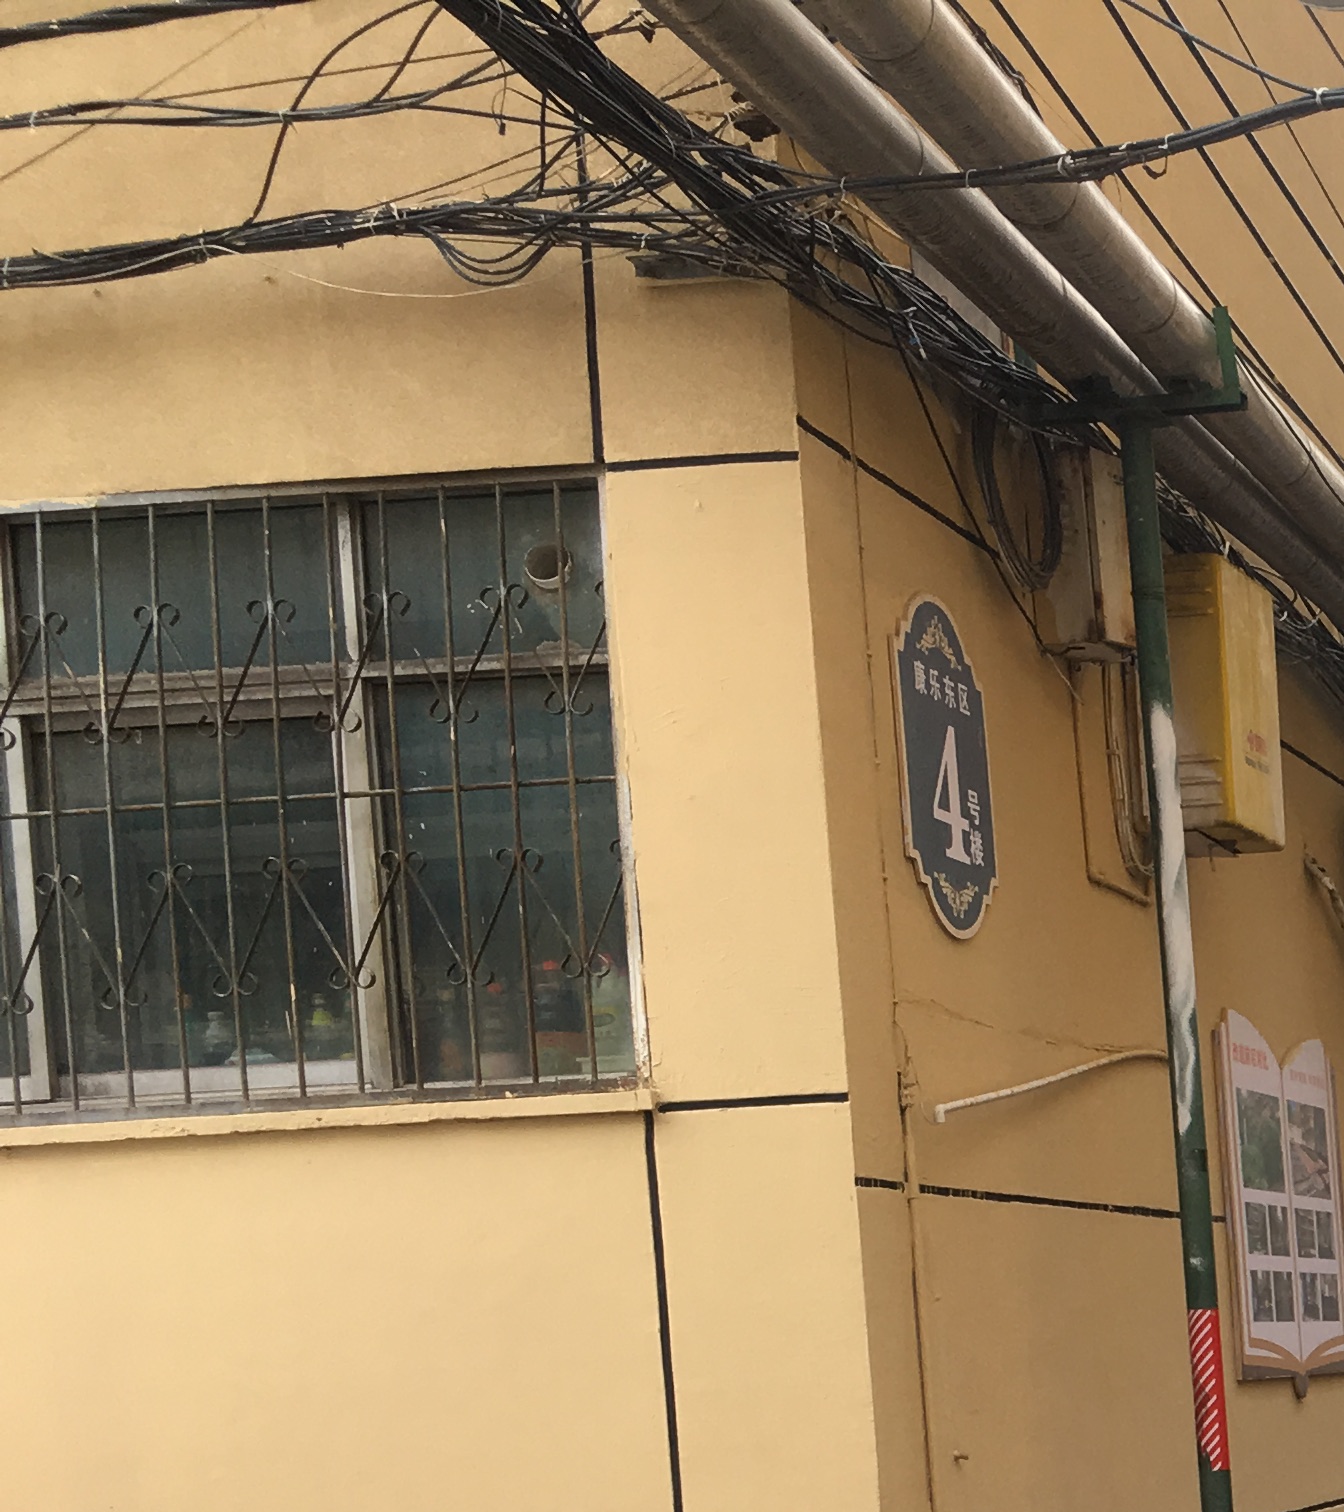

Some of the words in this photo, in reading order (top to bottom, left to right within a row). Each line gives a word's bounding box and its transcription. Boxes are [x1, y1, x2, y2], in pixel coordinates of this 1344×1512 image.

[914, 660, 970, 716] 康乐东区
[934, 725, 971, 865] 4
[967, 789, 984, 866] 号楼
